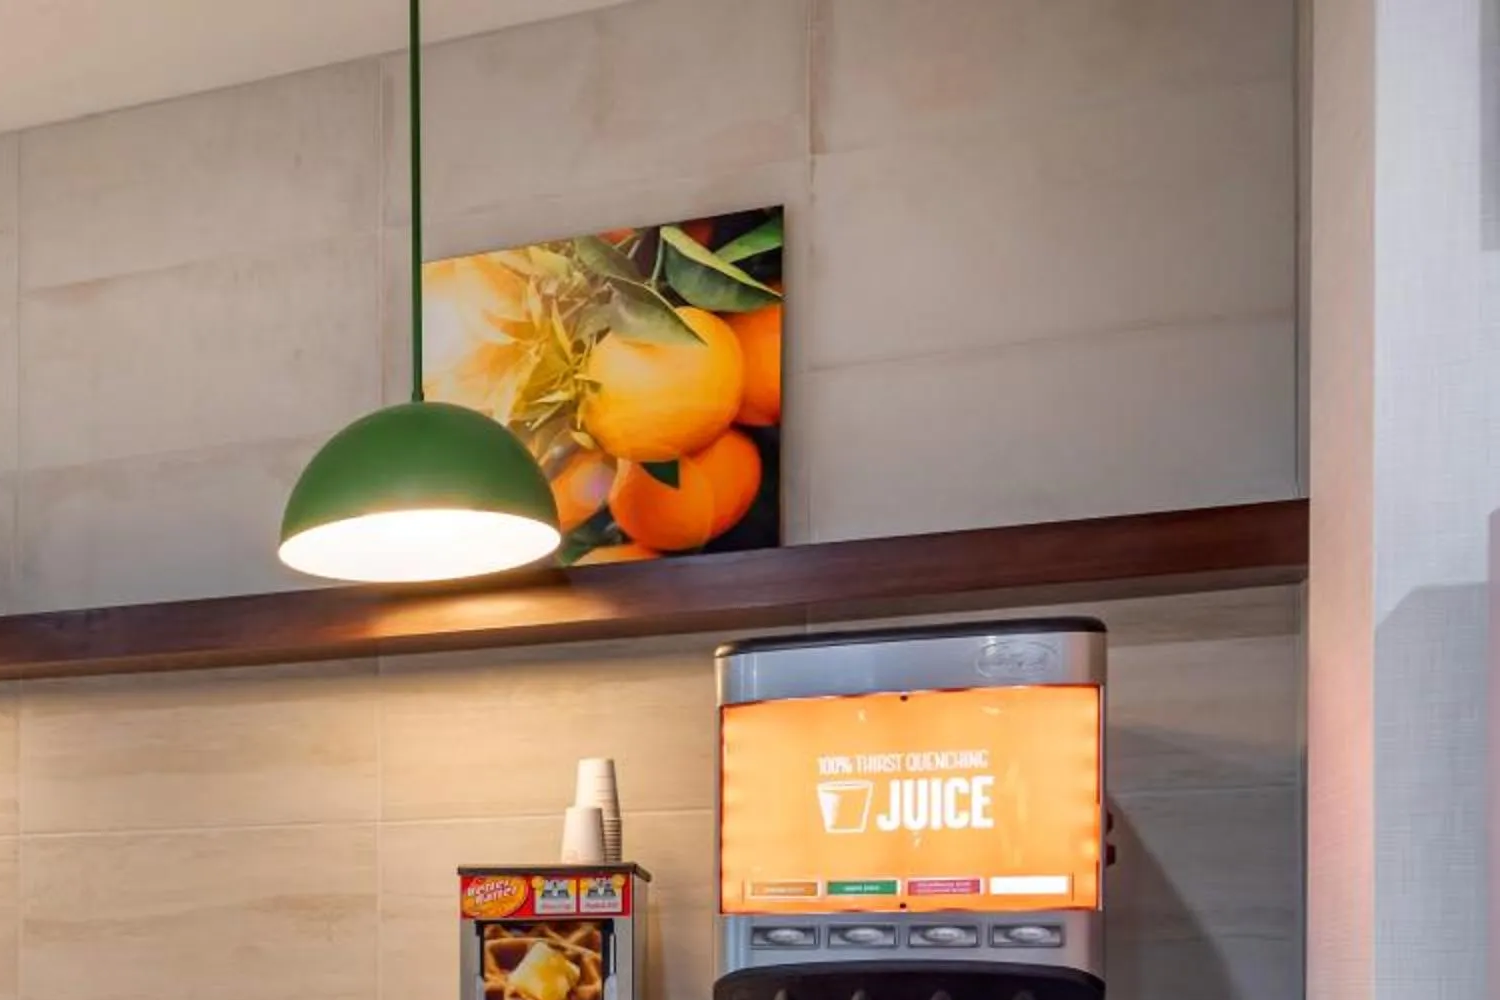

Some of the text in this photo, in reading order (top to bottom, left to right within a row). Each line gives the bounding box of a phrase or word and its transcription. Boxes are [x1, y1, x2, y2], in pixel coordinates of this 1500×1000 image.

[818, 750, 989, 775] 100% THIRST QUENCHING
[876, 775, 996, 832] JUICE
